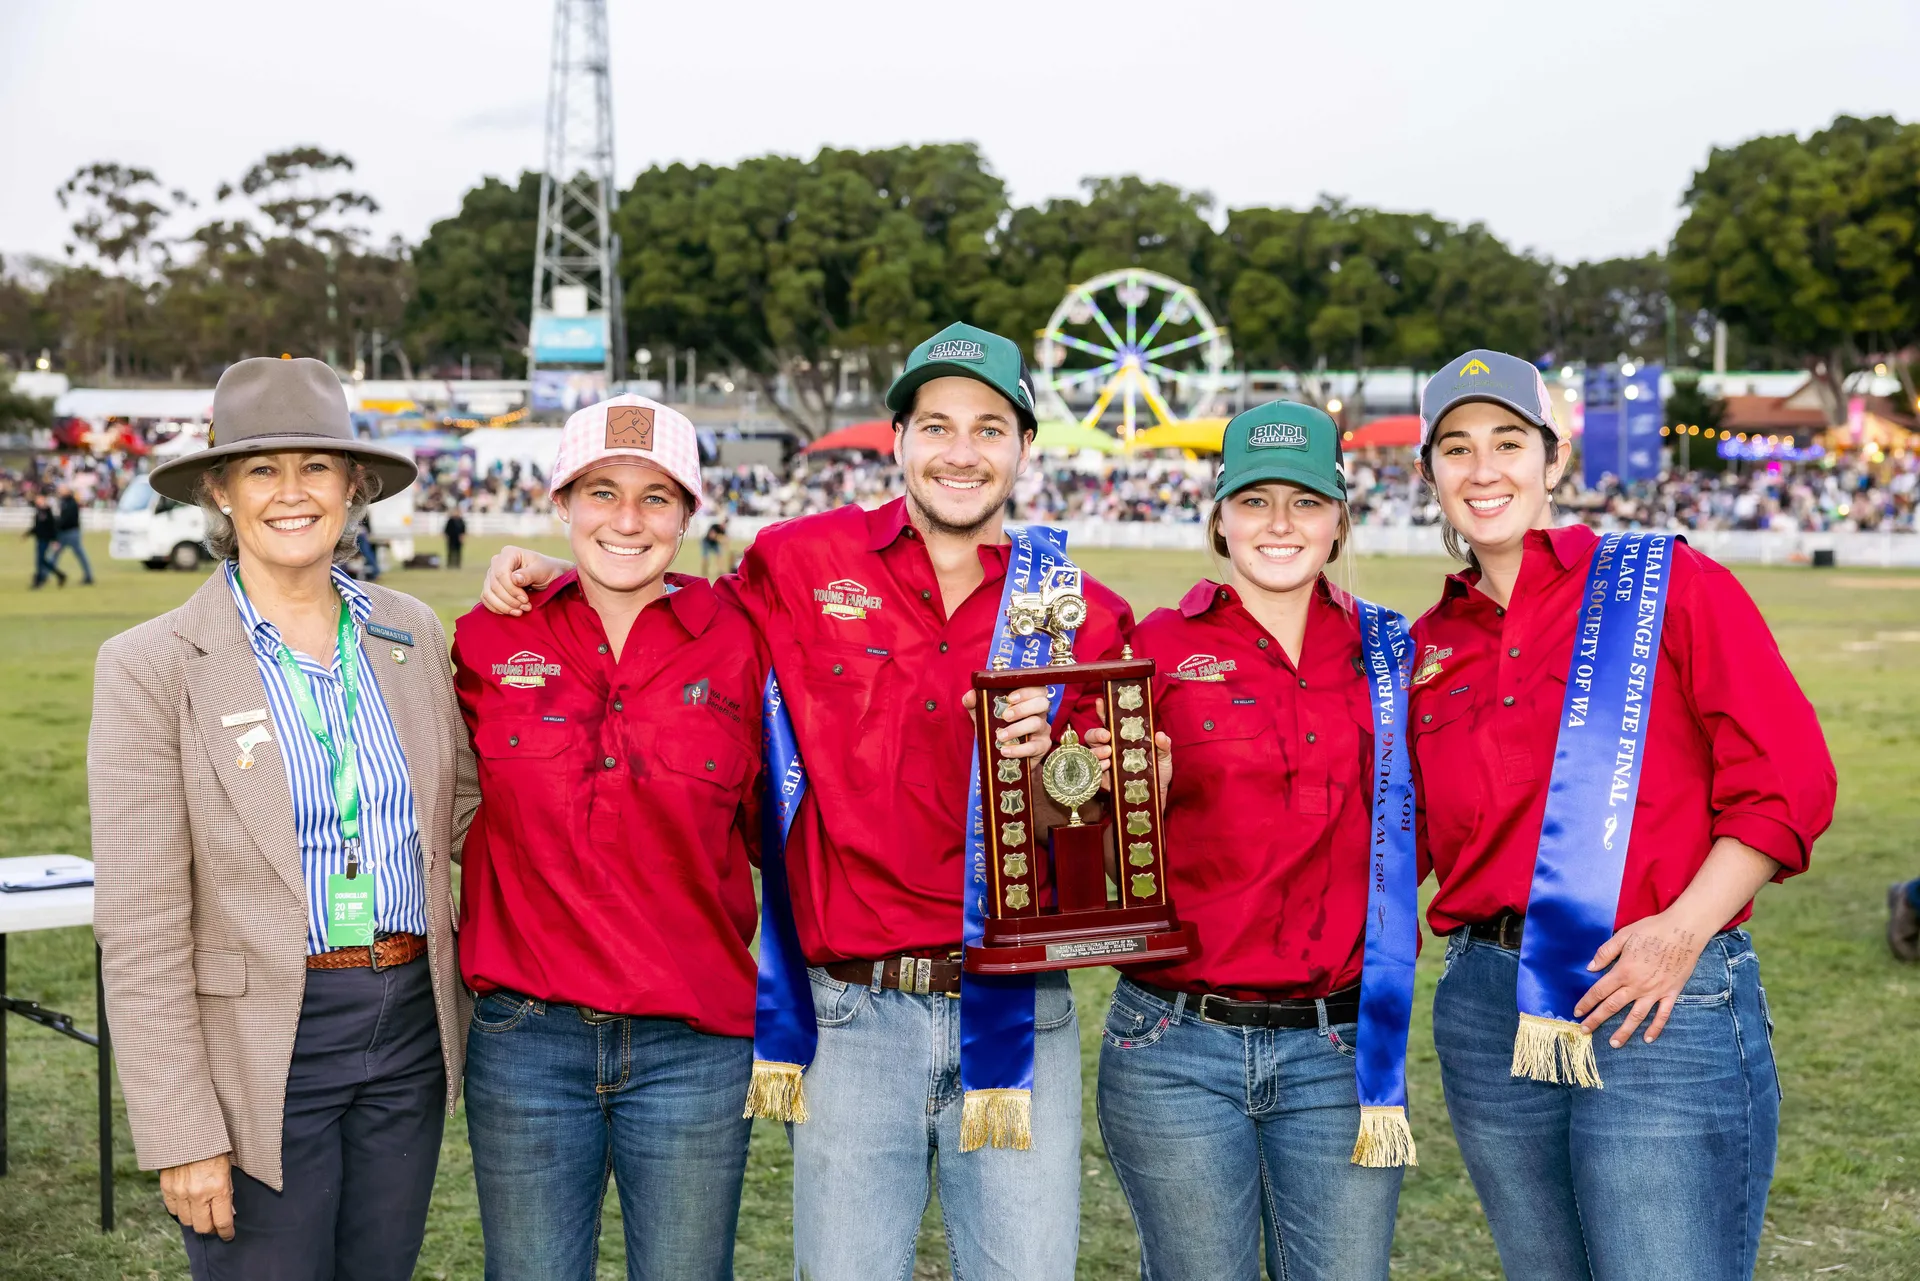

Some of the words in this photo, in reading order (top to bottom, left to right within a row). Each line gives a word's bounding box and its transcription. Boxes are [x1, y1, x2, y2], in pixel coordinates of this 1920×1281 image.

[933, 340, 980, 353] BINDI
[1254, 424, 1303, 438] BINDI
[1615, 542, 1640, 602] PLACE
[813, 588, 844, 604] YOUNG
[845, 593, 882, 609] FARMER
[1633, 536, 1666, 659] CHALLENGE
[370, 625, 410, 642] RINGMASTER
[1580, 579, 1608, 661] SOCIETY
[345, 661, 354, 693] RASWA
[491, 663, 524, 676] YOUNG
[525, 663, 561, 676] FARMER
[1197, 660, 1237, 676] FARMER
[1575, 664, 1594, 692] OF
[709, 688, 721, 699] WA
[722, 696, 741, 711] Next
[1370, 650, 1395, 726] FARMER
[1622, 662, 1647, 733] STATE
[1568, 696, 1590, 728] WA
[1377, 731, 1394, 808] YOUNG
[1609, 737, 1636, 807] FINAL
[1401, 768, 1414, 832] ROYA
[1375, 814, 1386, 846] WA
[1375, 853, 1386, 893] 2024
[335, 902, 346, 911] 20
[335, 911, 345, 920] 24
